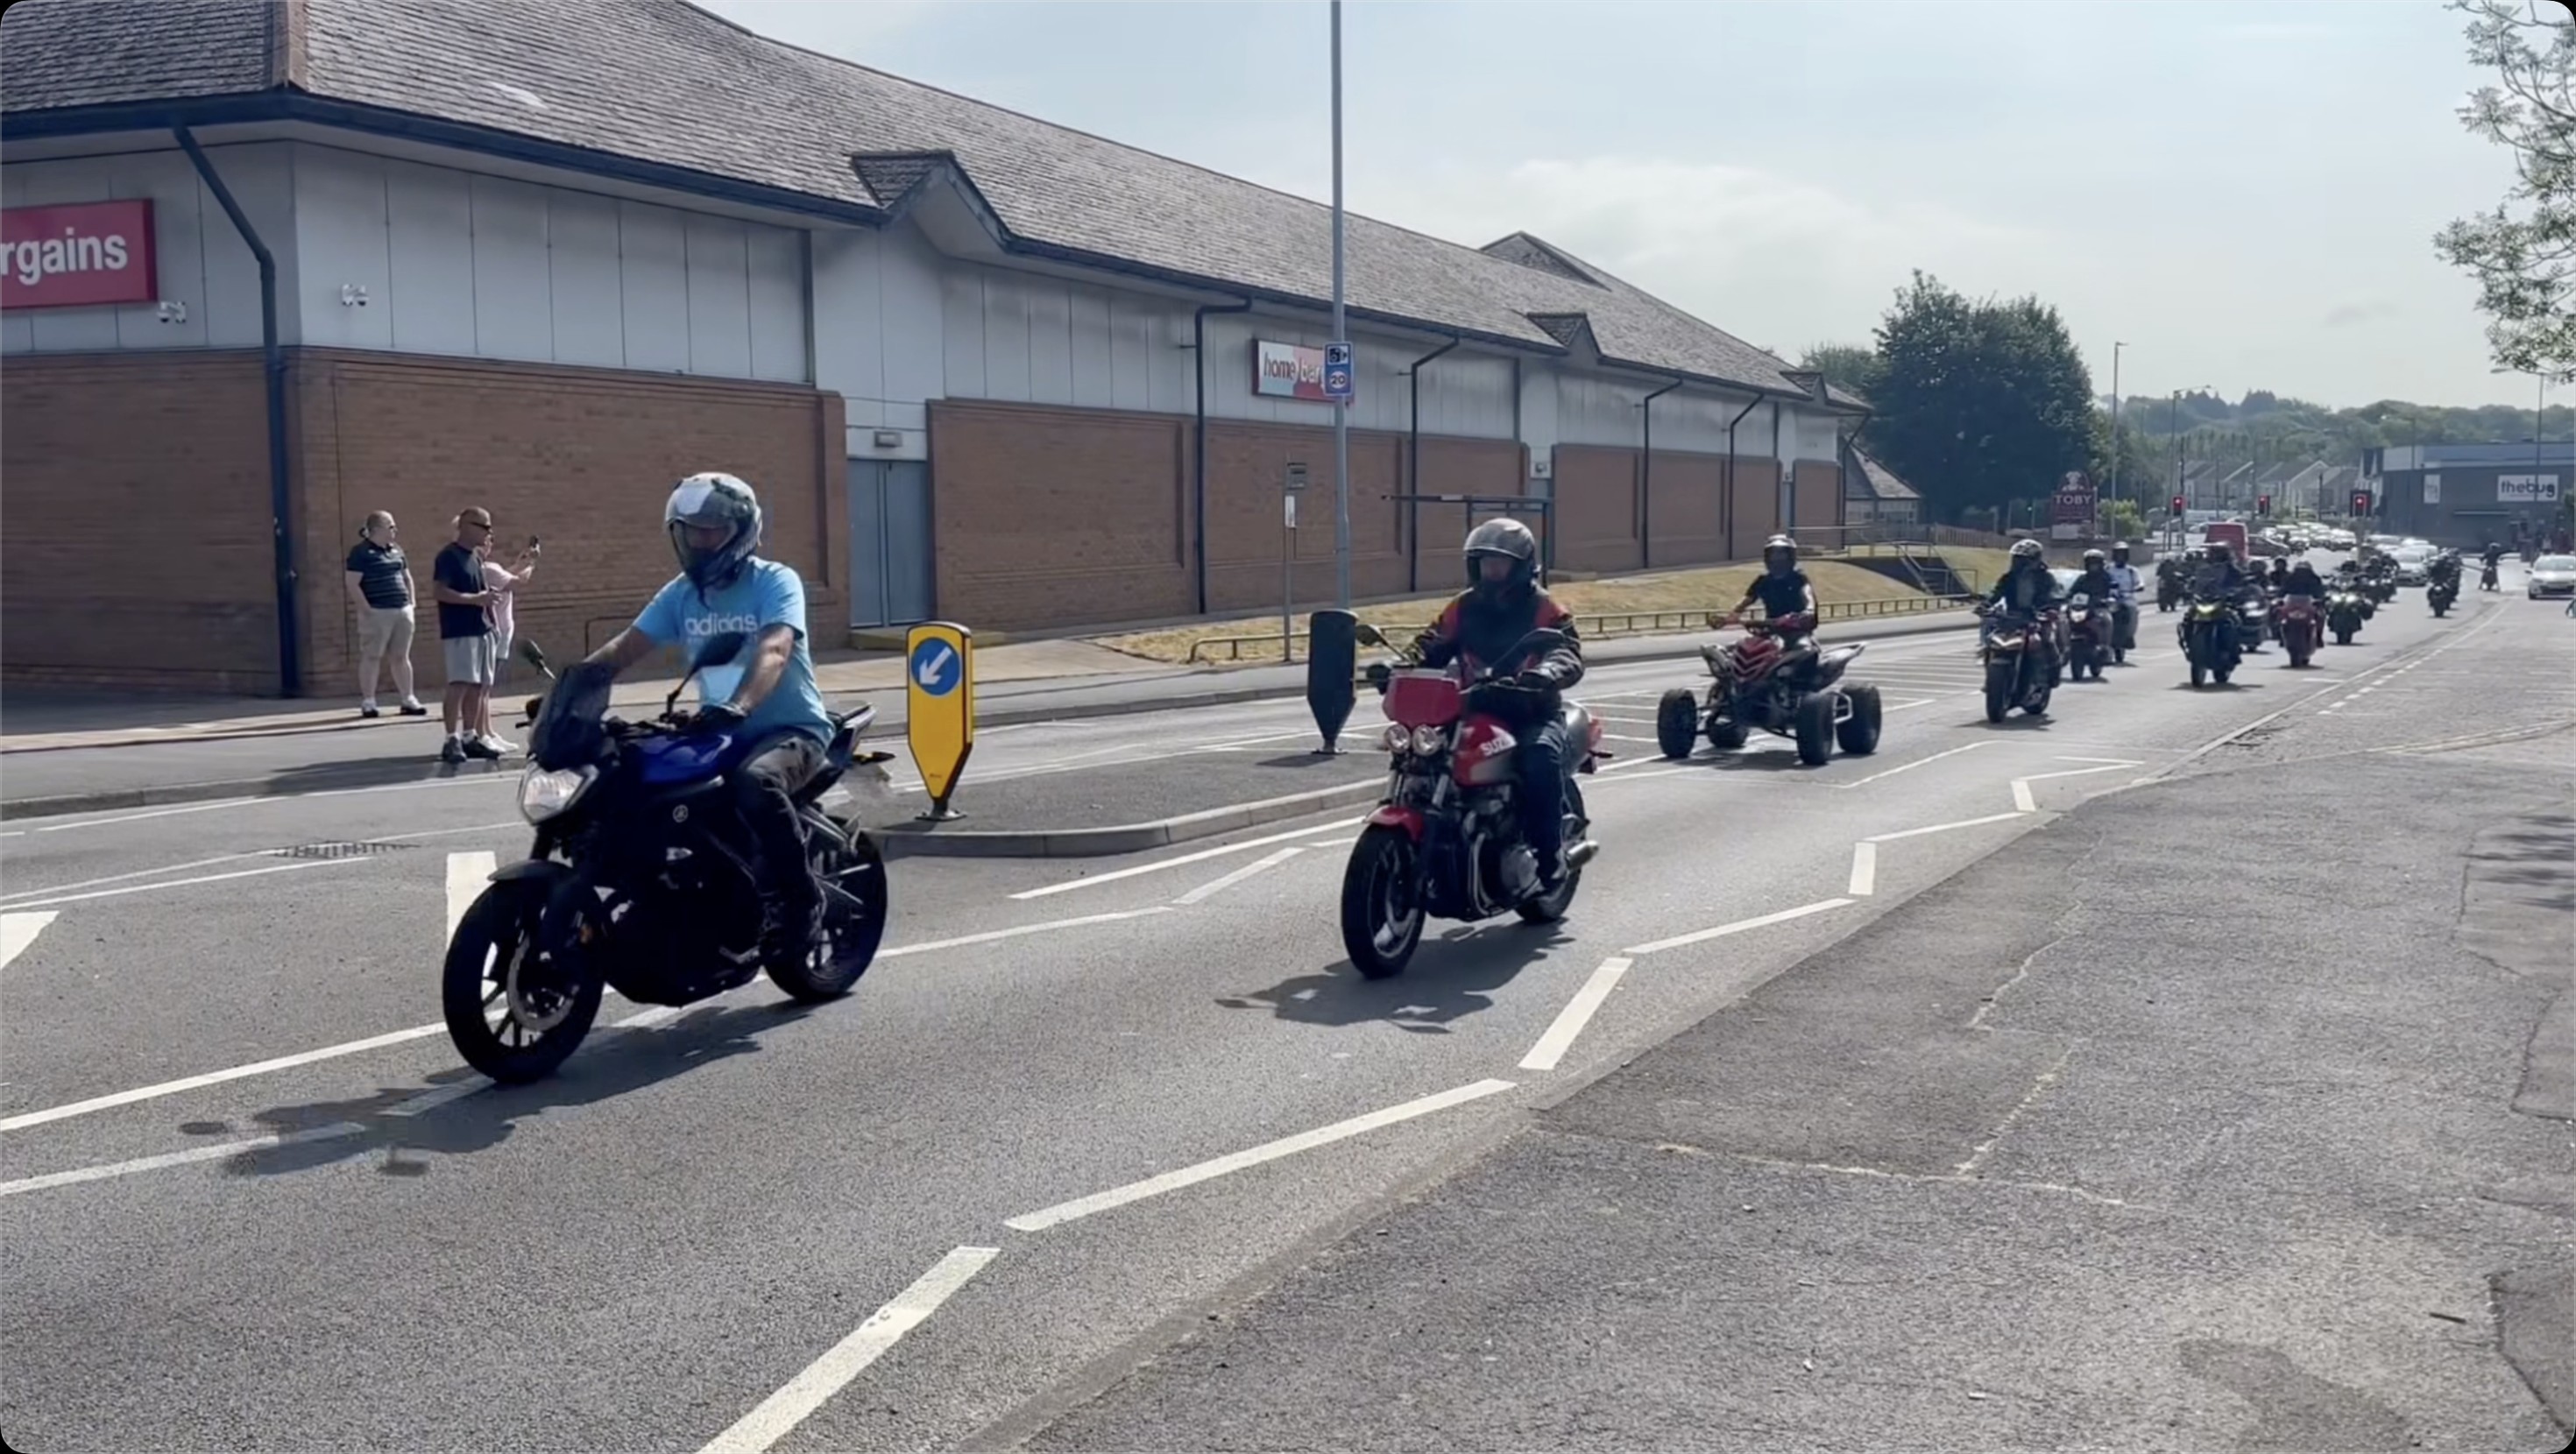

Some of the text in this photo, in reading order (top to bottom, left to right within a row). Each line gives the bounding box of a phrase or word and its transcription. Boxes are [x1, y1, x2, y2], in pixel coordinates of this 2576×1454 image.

[1263, 350, 1327, 390] home bar
[1331, 374, 1347, 385] 20
[2054, 494, 2092, 505] TOBY
[684, 612, 758, 636] adidas
